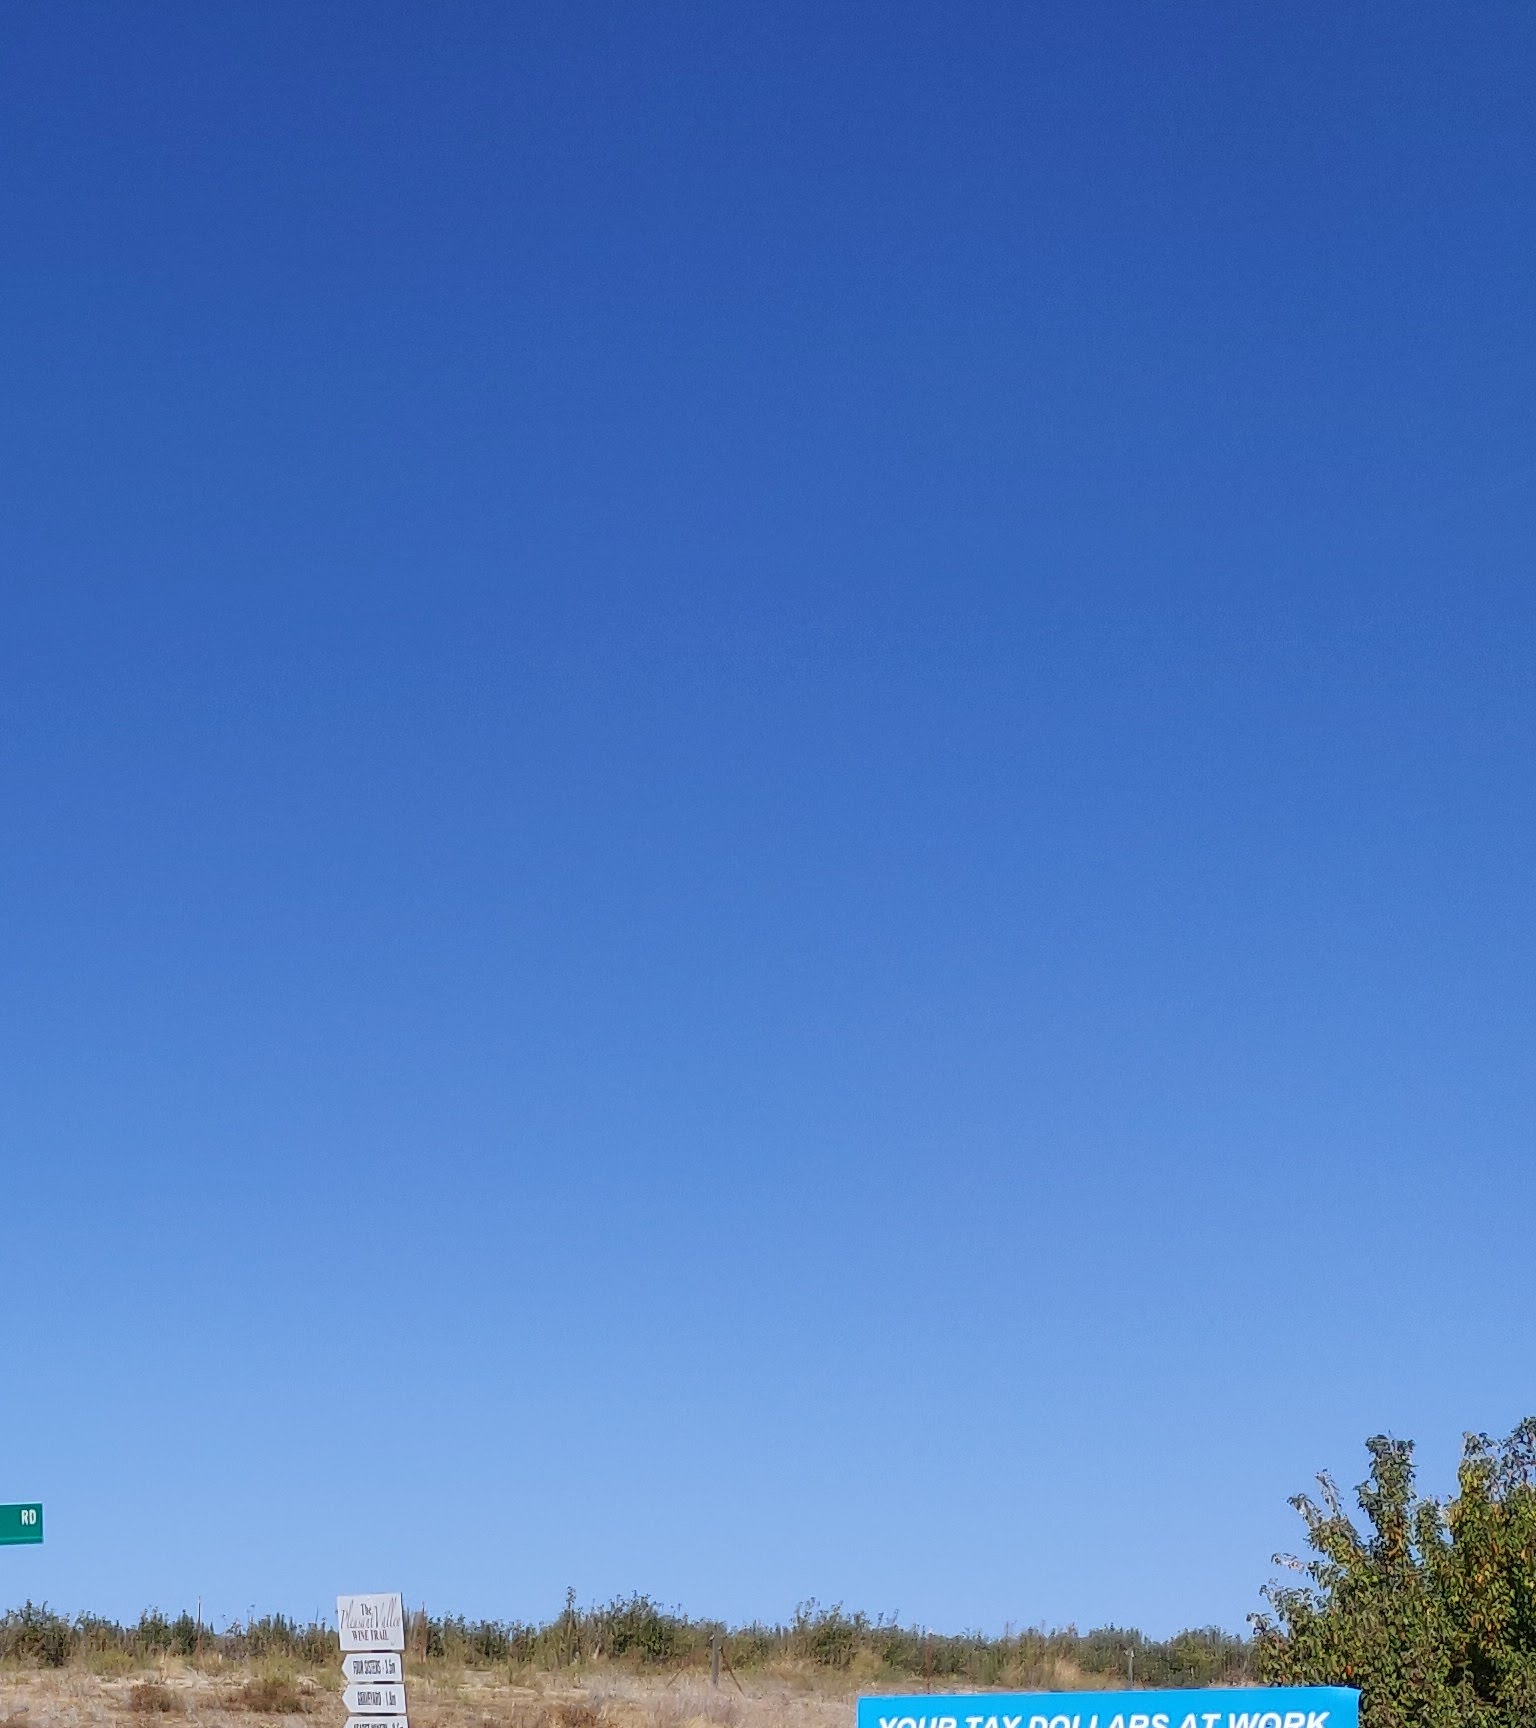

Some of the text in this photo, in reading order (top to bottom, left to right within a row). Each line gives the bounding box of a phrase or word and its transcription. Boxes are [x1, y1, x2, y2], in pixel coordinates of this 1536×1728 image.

[21, 1509, 37, 1525] RD
[360, 1603, 372, 1616] The
[351, 1630, 389, 1642] WINE TRAIL
